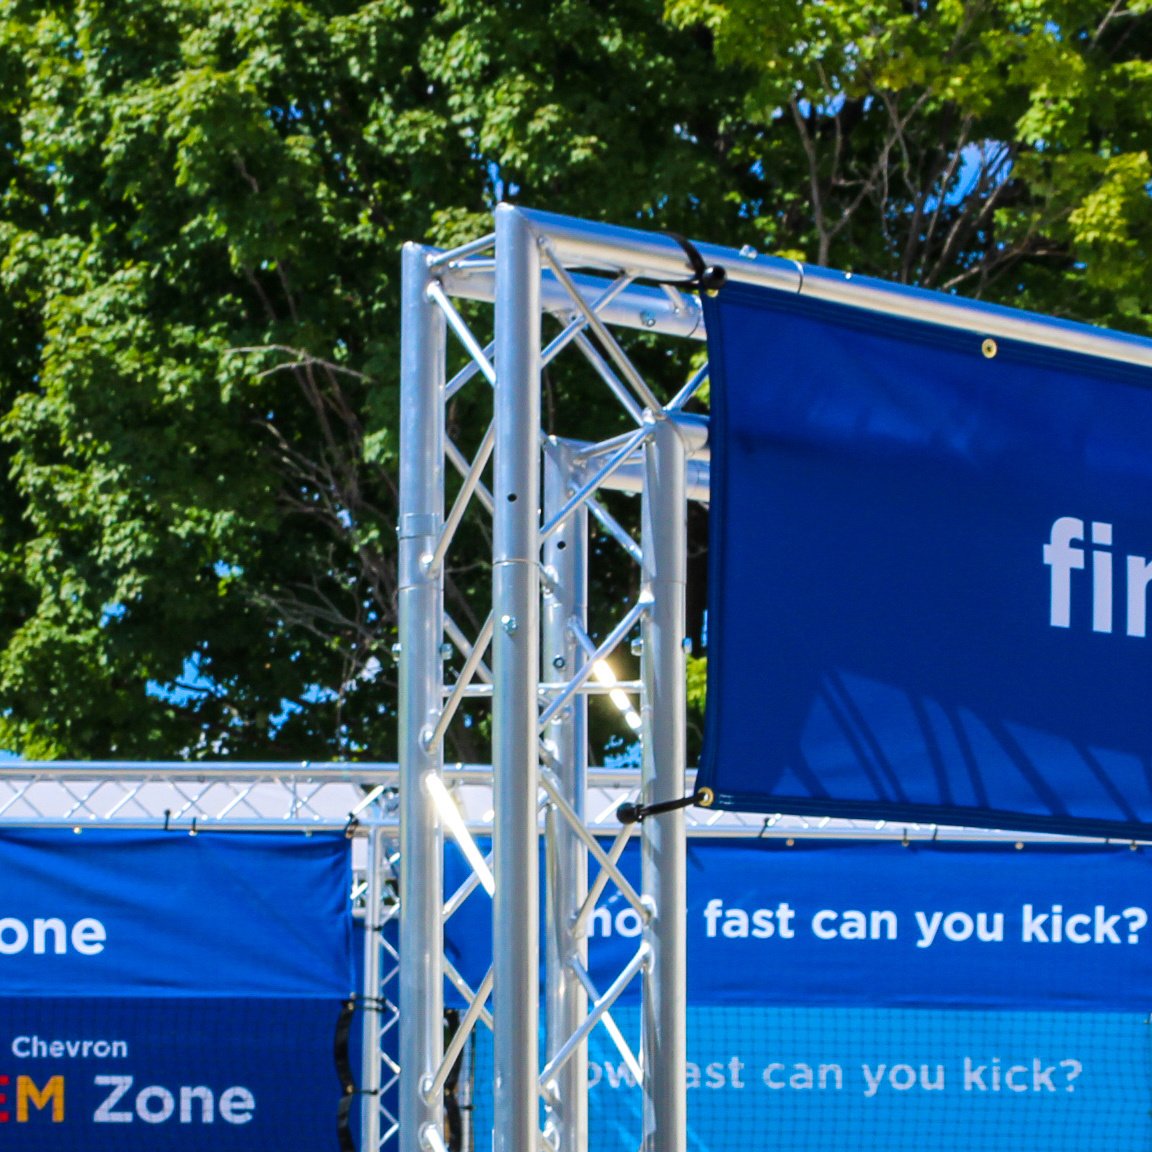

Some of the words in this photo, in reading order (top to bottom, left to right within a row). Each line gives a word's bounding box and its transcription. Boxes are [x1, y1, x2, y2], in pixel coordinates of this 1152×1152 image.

[703, 898, 796, 939] fast
[811, 908, 898, 940] can
[914, 910, 1005, 948] you
[1021, 903, 1149, 945] kick?
[11, 1035, 129, 1058] Chevron
[93, 1074, 256, 1124] Zone
[686, 1055, 746, 1090] ast
[761, 1061, 843, 1090] can
[861, 1063, 946, 1098] you
[962, 1055, 1083, 1093] kick?
